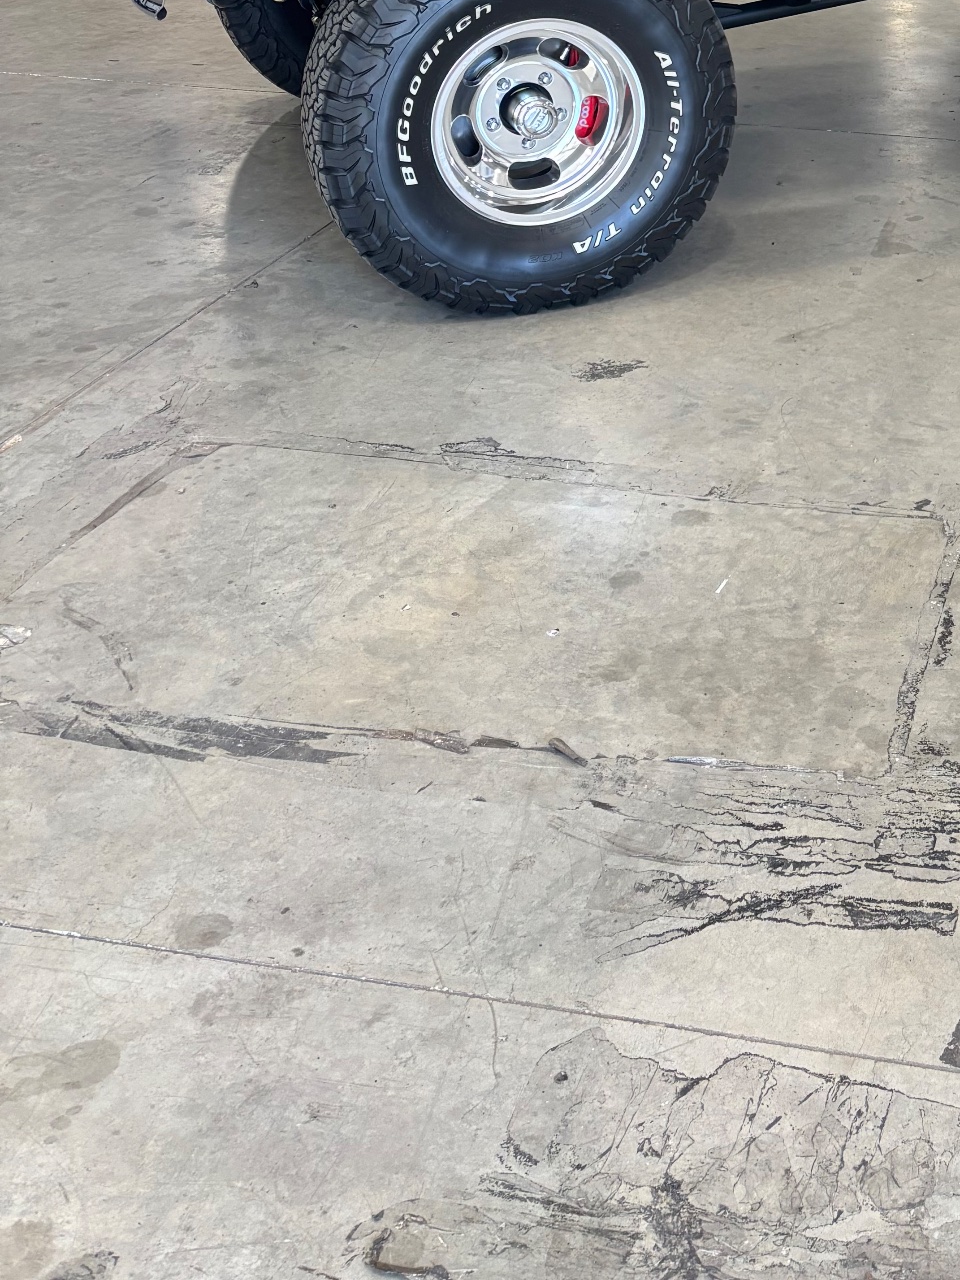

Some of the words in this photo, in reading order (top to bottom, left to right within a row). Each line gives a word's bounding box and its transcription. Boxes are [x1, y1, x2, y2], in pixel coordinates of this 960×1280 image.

[397, 4, 492, 187] BFGoodrich
[629, 51, 684, 216] All-Terrain
[571, 221, 622, 255] T/A
